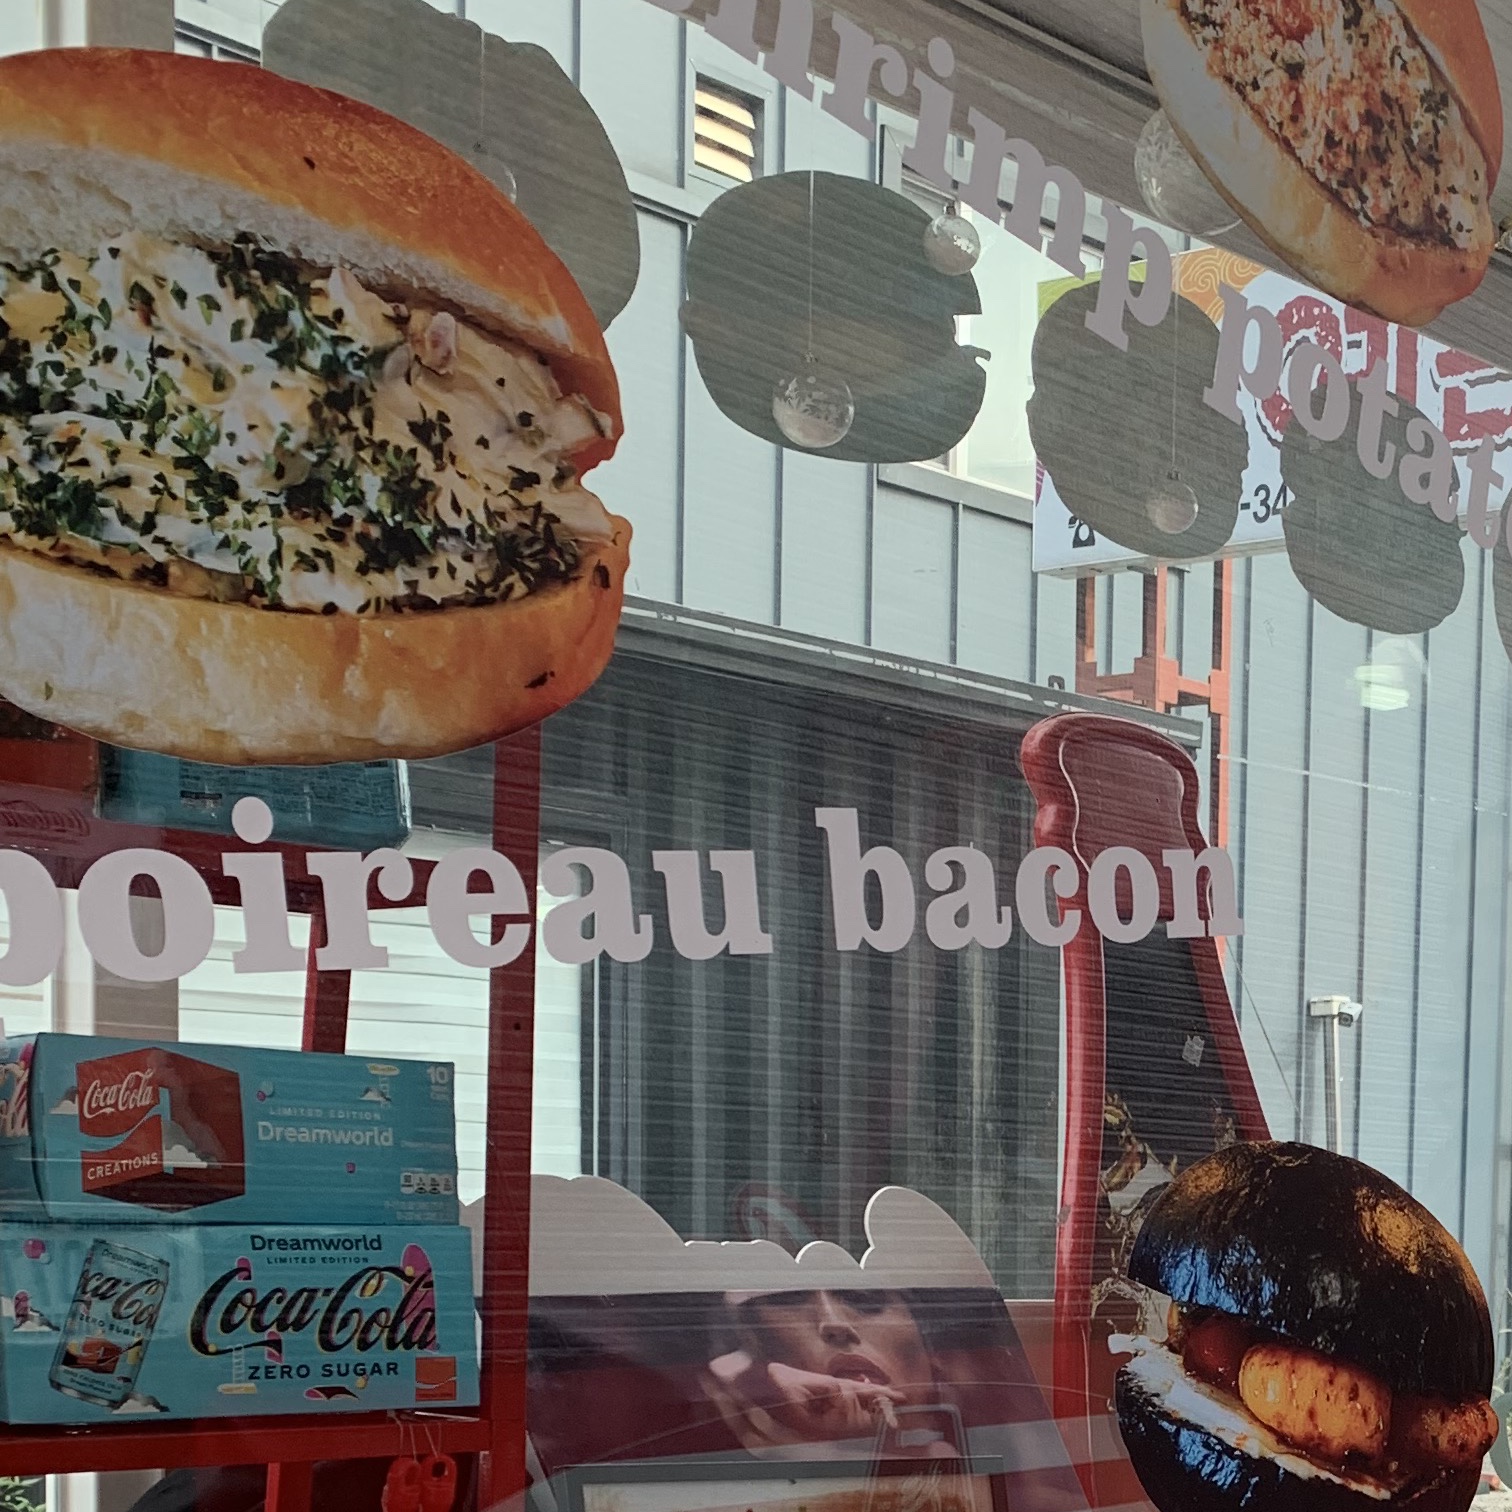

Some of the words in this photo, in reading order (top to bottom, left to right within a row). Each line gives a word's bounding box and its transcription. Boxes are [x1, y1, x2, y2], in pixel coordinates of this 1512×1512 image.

[643, 0, 1172, 351] hrimp
[815, 807, 1244, 953] bacon
[83, 1067, 154, 1119] Coca-Cola
[329, 1110, 382, 1121] EDITION
[257, 1121, 394, 1147] Dreamworld
[87, 1152, 159, 1181] CREATIONS
[250, 1234, 382, 1252] Dreamworld
[266, 1256, 316, 1266] LIMITED
[321, 1256, 370, 1265] EDITION
[189, 1265, 438, 1357] Coca-Cola
[247, 1364, 311, 1381] ZERO
[320, 1362, 400, 1378] SUGAR
